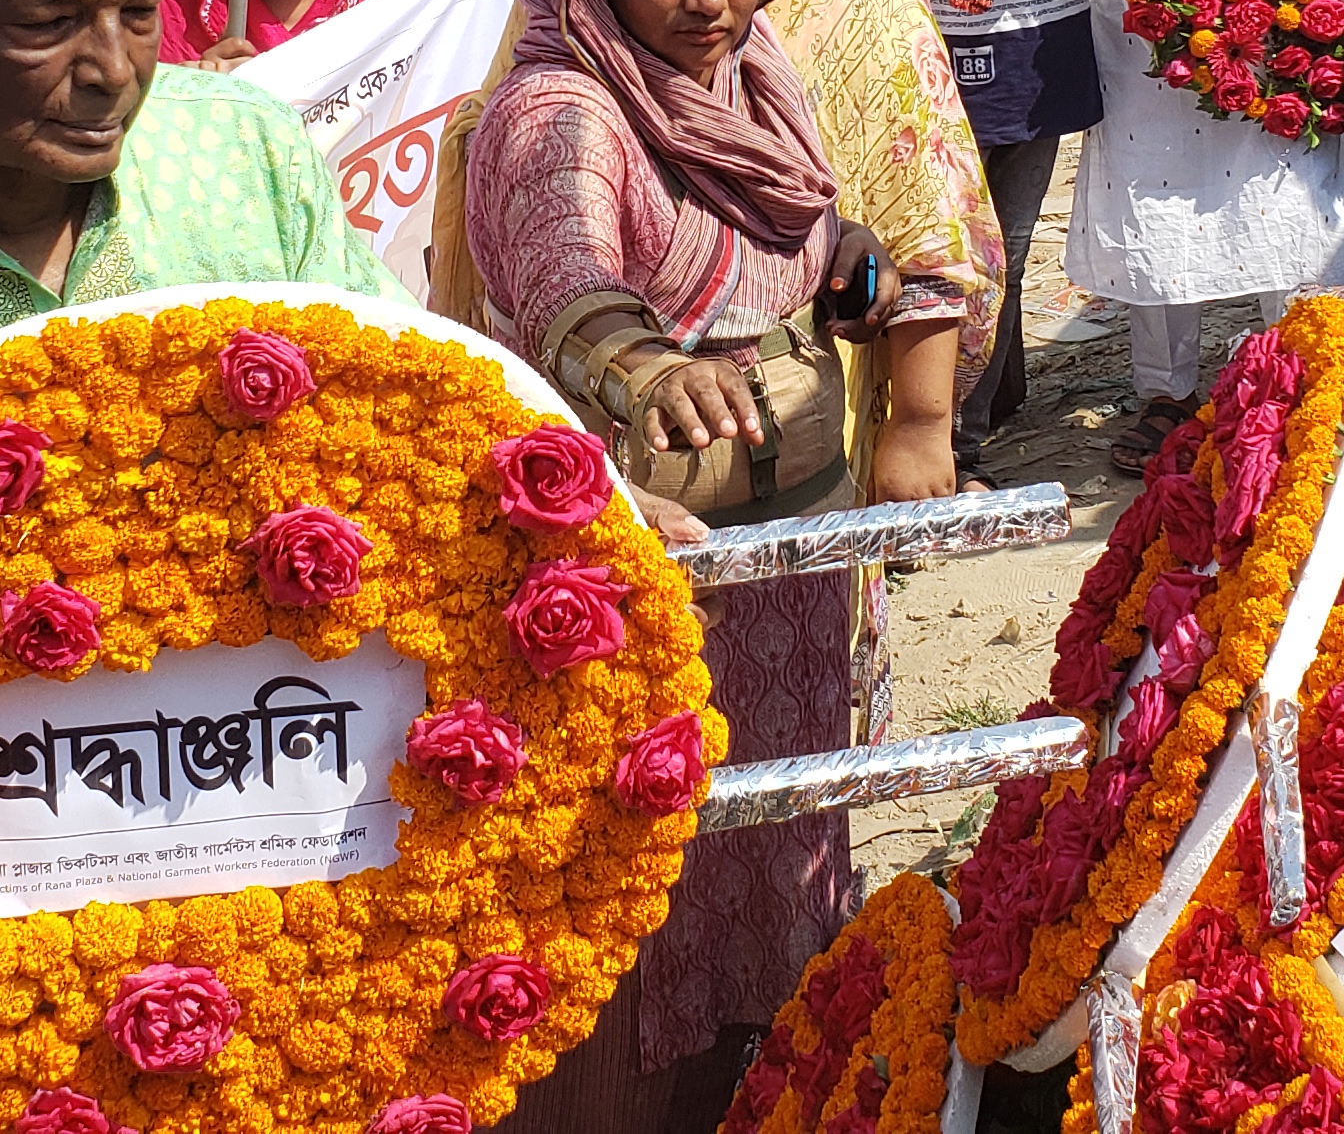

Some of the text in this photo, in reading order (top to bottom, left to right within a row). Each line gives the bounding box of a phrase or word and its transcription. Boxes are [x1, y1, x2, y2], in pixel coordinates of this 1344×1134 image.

[962, 57, 986, 74] 88
[303, 83, 350, 126] জদুর
[357, 66, 388, 100] এক
[12, 861, 53, 878] প্লাজার
[56, 851, 120, 873] ভিকটিমস
[123, 851, 152, 865] এবং
[155, 843, 199, 862] জাতীয়
[203, 837, 256, 856] গার্মেন্টস
[259, 833, 298, 851] শ্রমিক
[301, 826, 368, 849] ফেডারেশন
[31, 882, 42, 893] of
[45, 880, 72, 891] Rana
[75, 876, 103, 888] Plaza
[106, 874, 115, 883] &
[118, 869, 161, 882] National
[165, 865, 211, 878] Garment
[214, 860, 258, 873] Workers
[261, 856, 316, 869] Federation
[319, 849, 360, 866] (NGWF)
